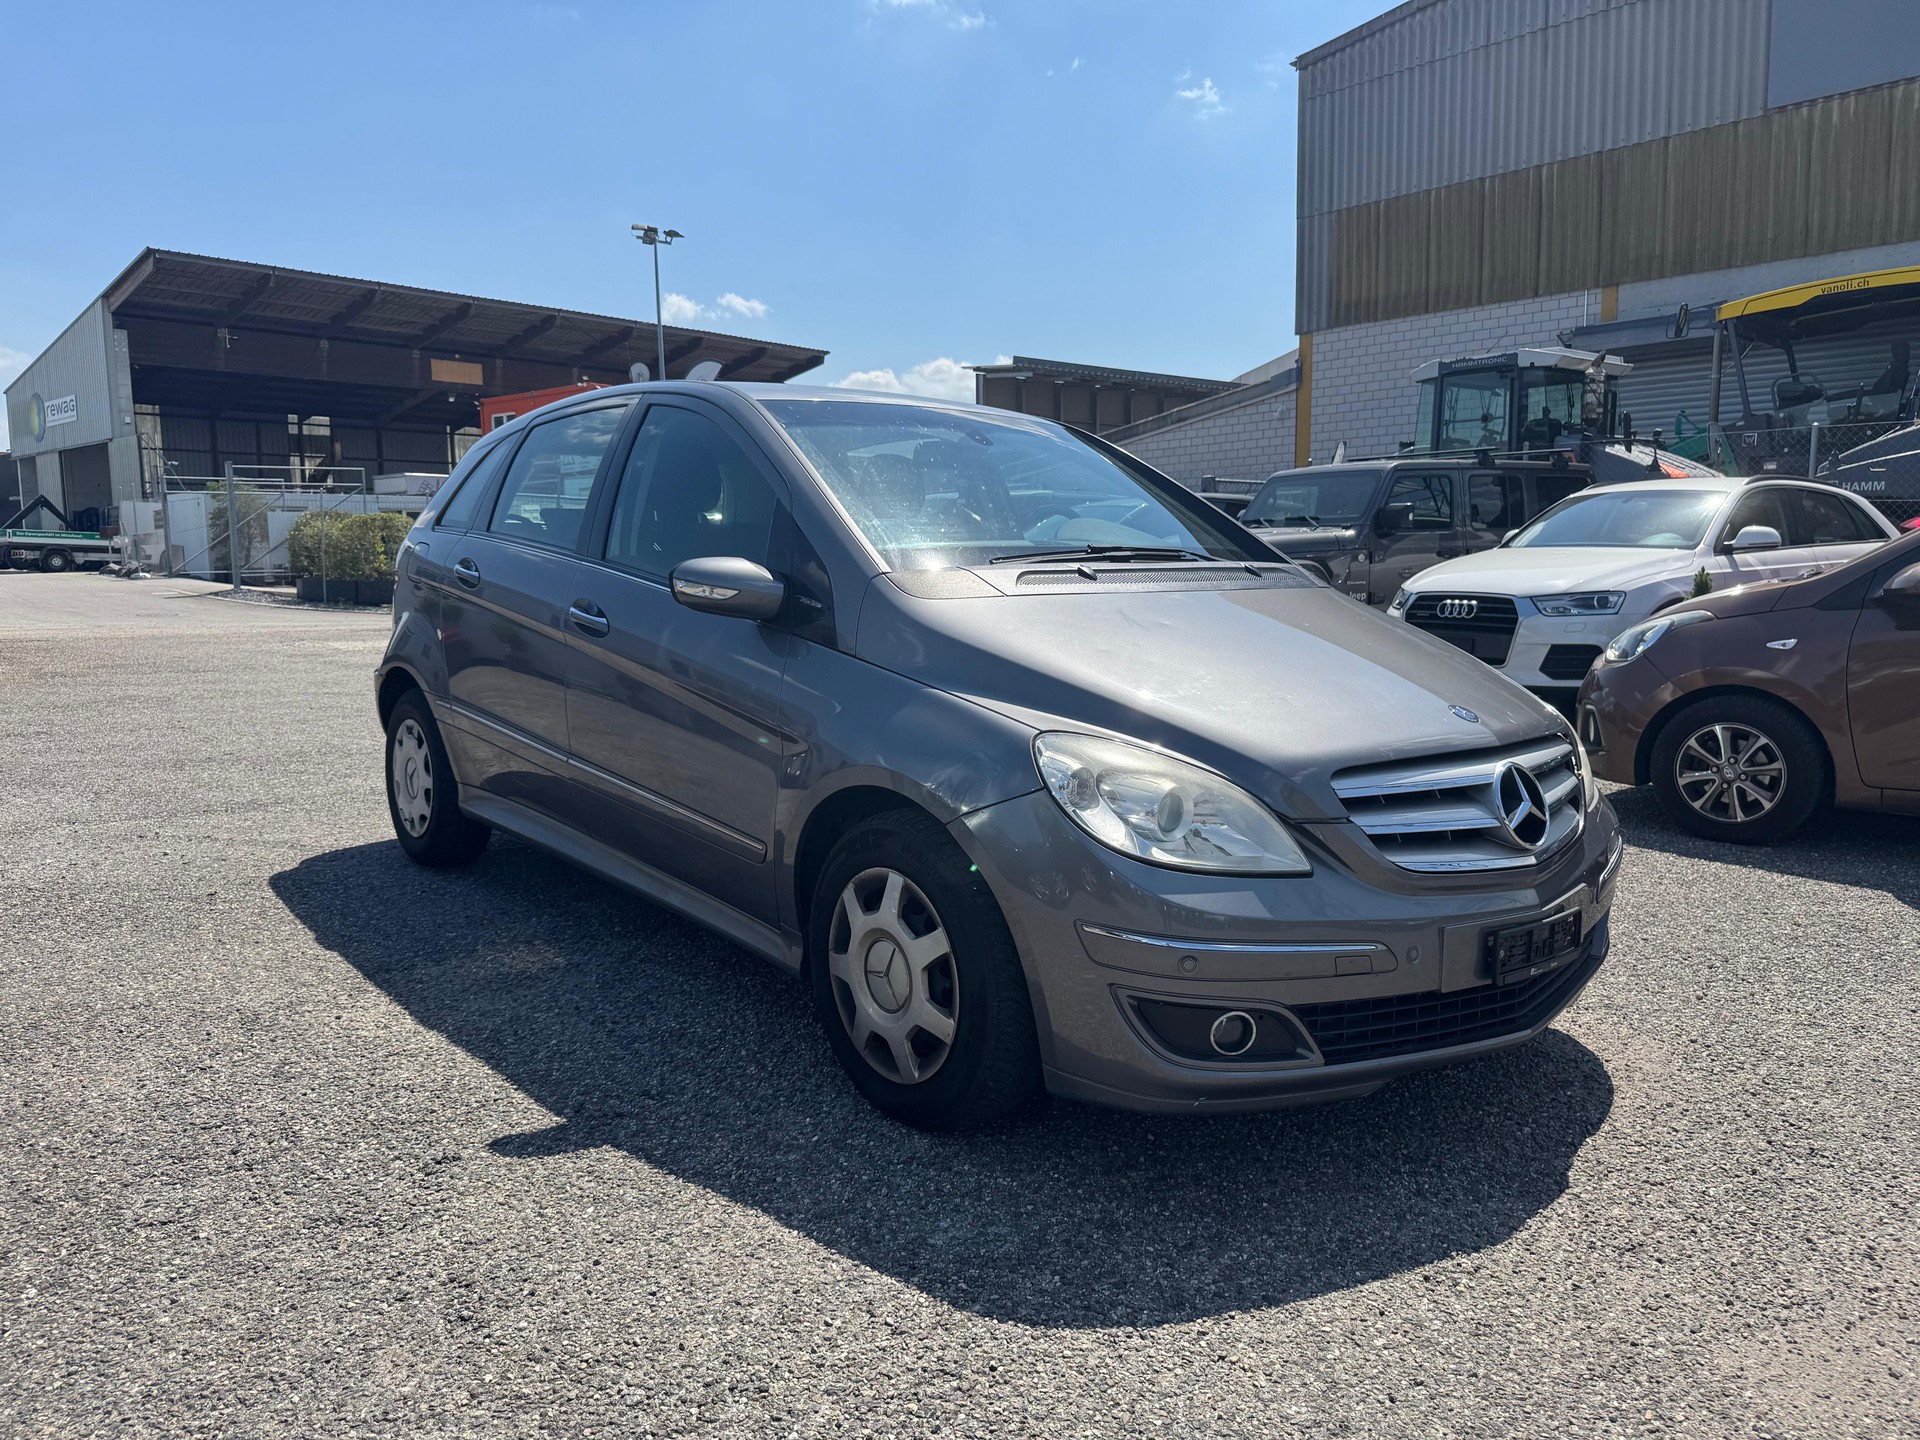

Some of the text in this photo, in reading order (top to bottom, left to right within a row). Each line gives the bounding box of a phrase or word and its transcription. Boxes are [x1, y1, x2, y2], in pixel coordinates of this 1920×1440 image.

[1821, 279, 1870, 294] vanoli.ch
[1451, 357, 1507, 368] HAMMTRONIC
[1842, 481, 1885, 491] HAMM
[1350, 591, 1366, 601] Jeep
